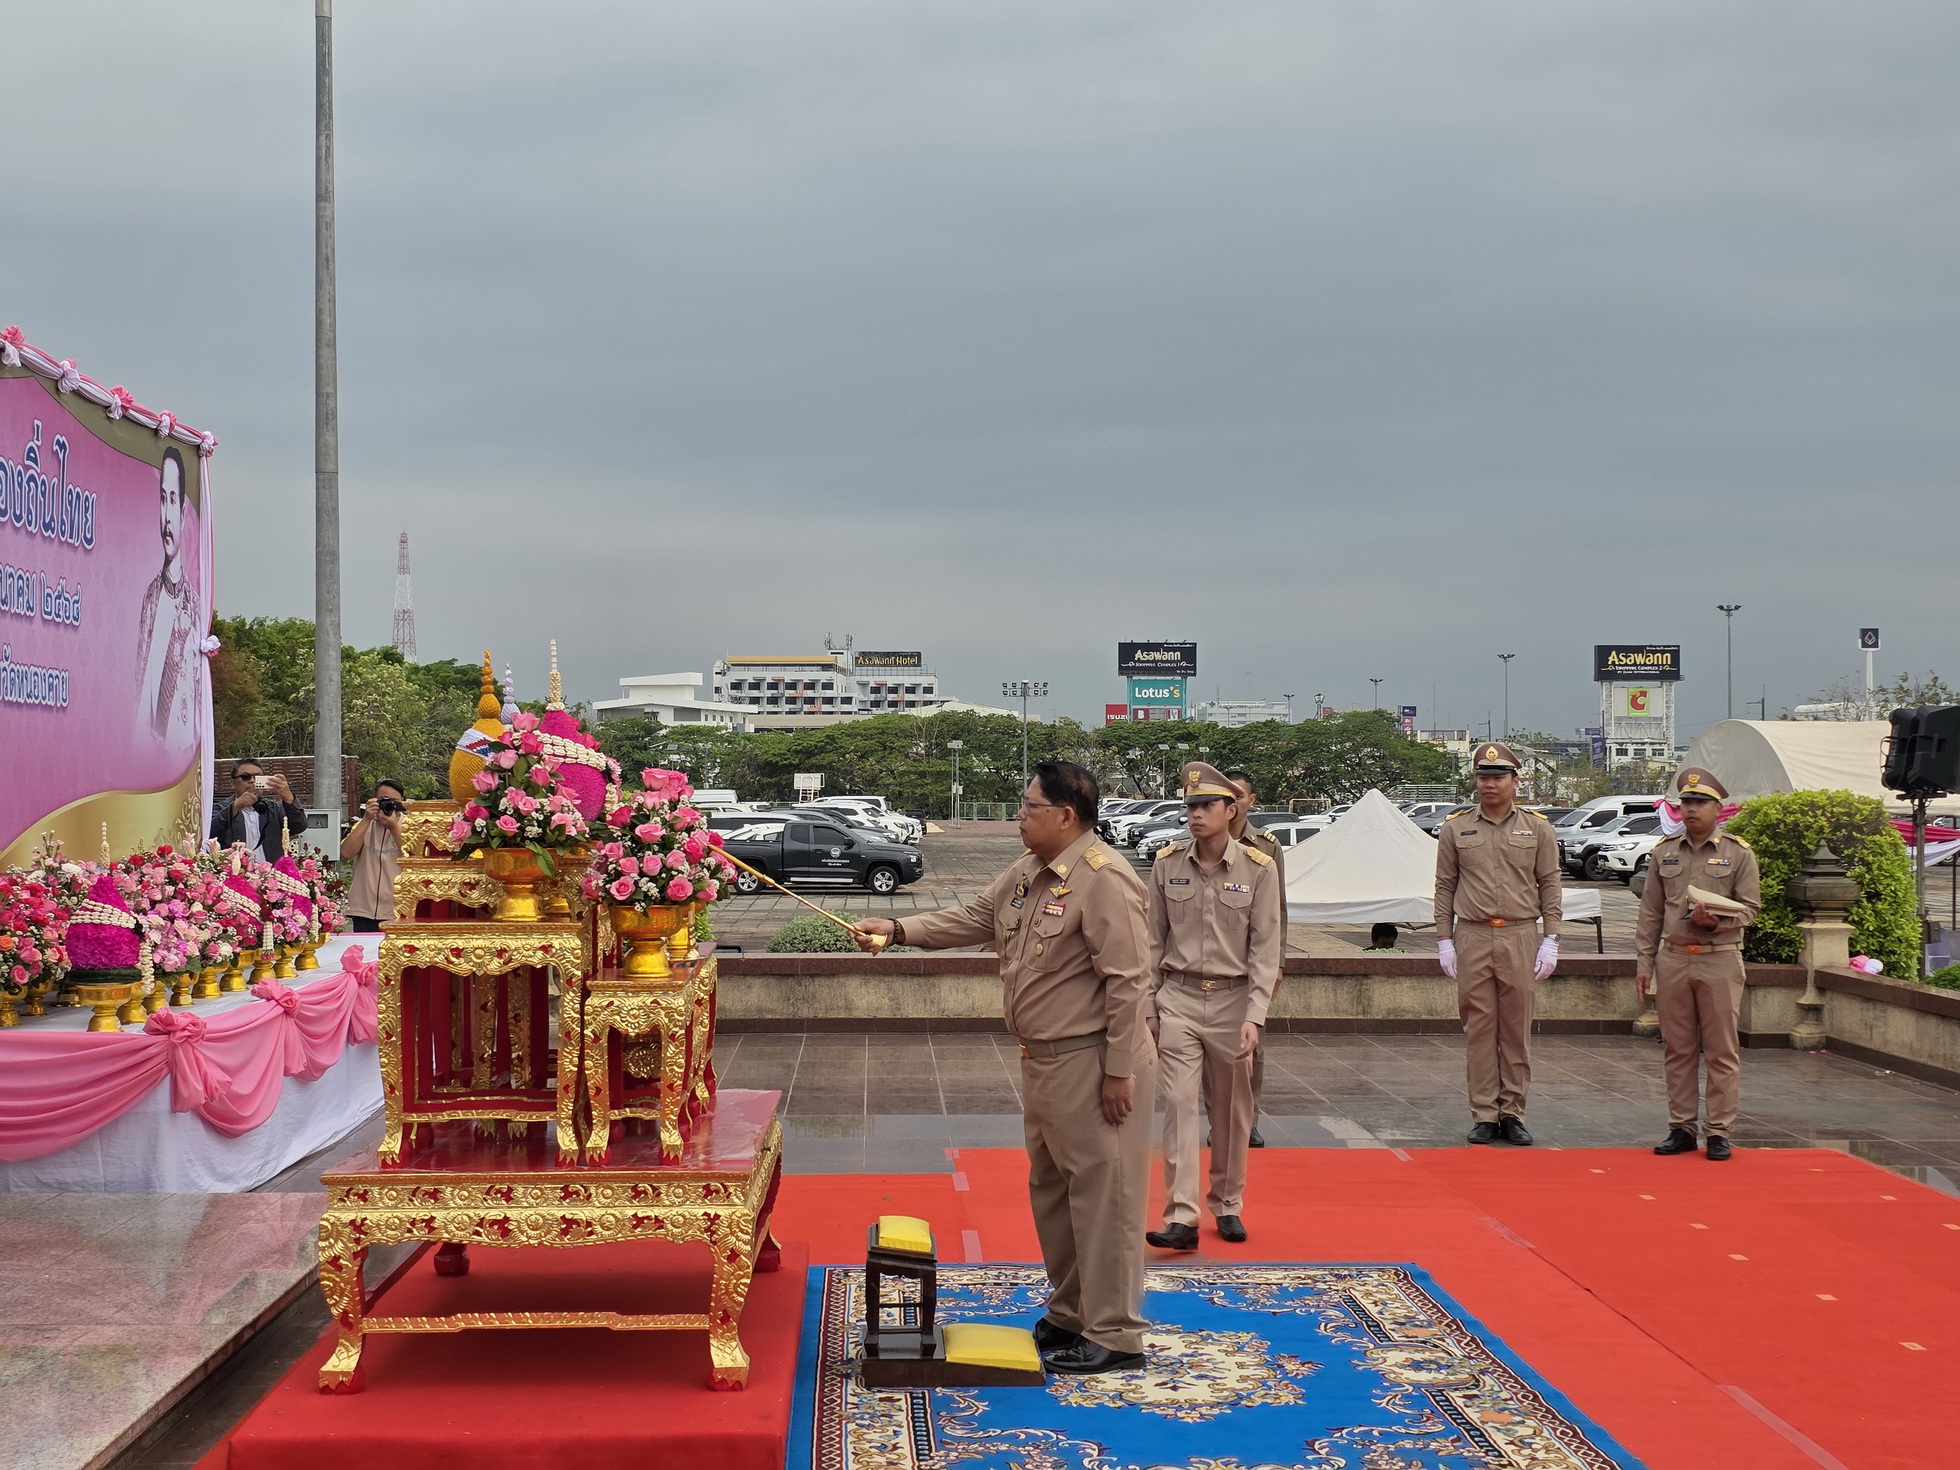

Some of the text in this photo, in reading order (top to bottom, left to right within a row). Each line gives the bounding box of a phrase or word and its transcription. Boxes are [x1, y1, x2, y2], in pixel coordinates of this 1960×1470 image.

[896, 656, 918, 666] Hotel
[1135, 648, 1181, 661] Asawann
[1608, 649, 1671, 665] Asawann
[0, 644, 69, 708] วัดหนองคาย
[1135, 686, 1180, 698] Lotus's
